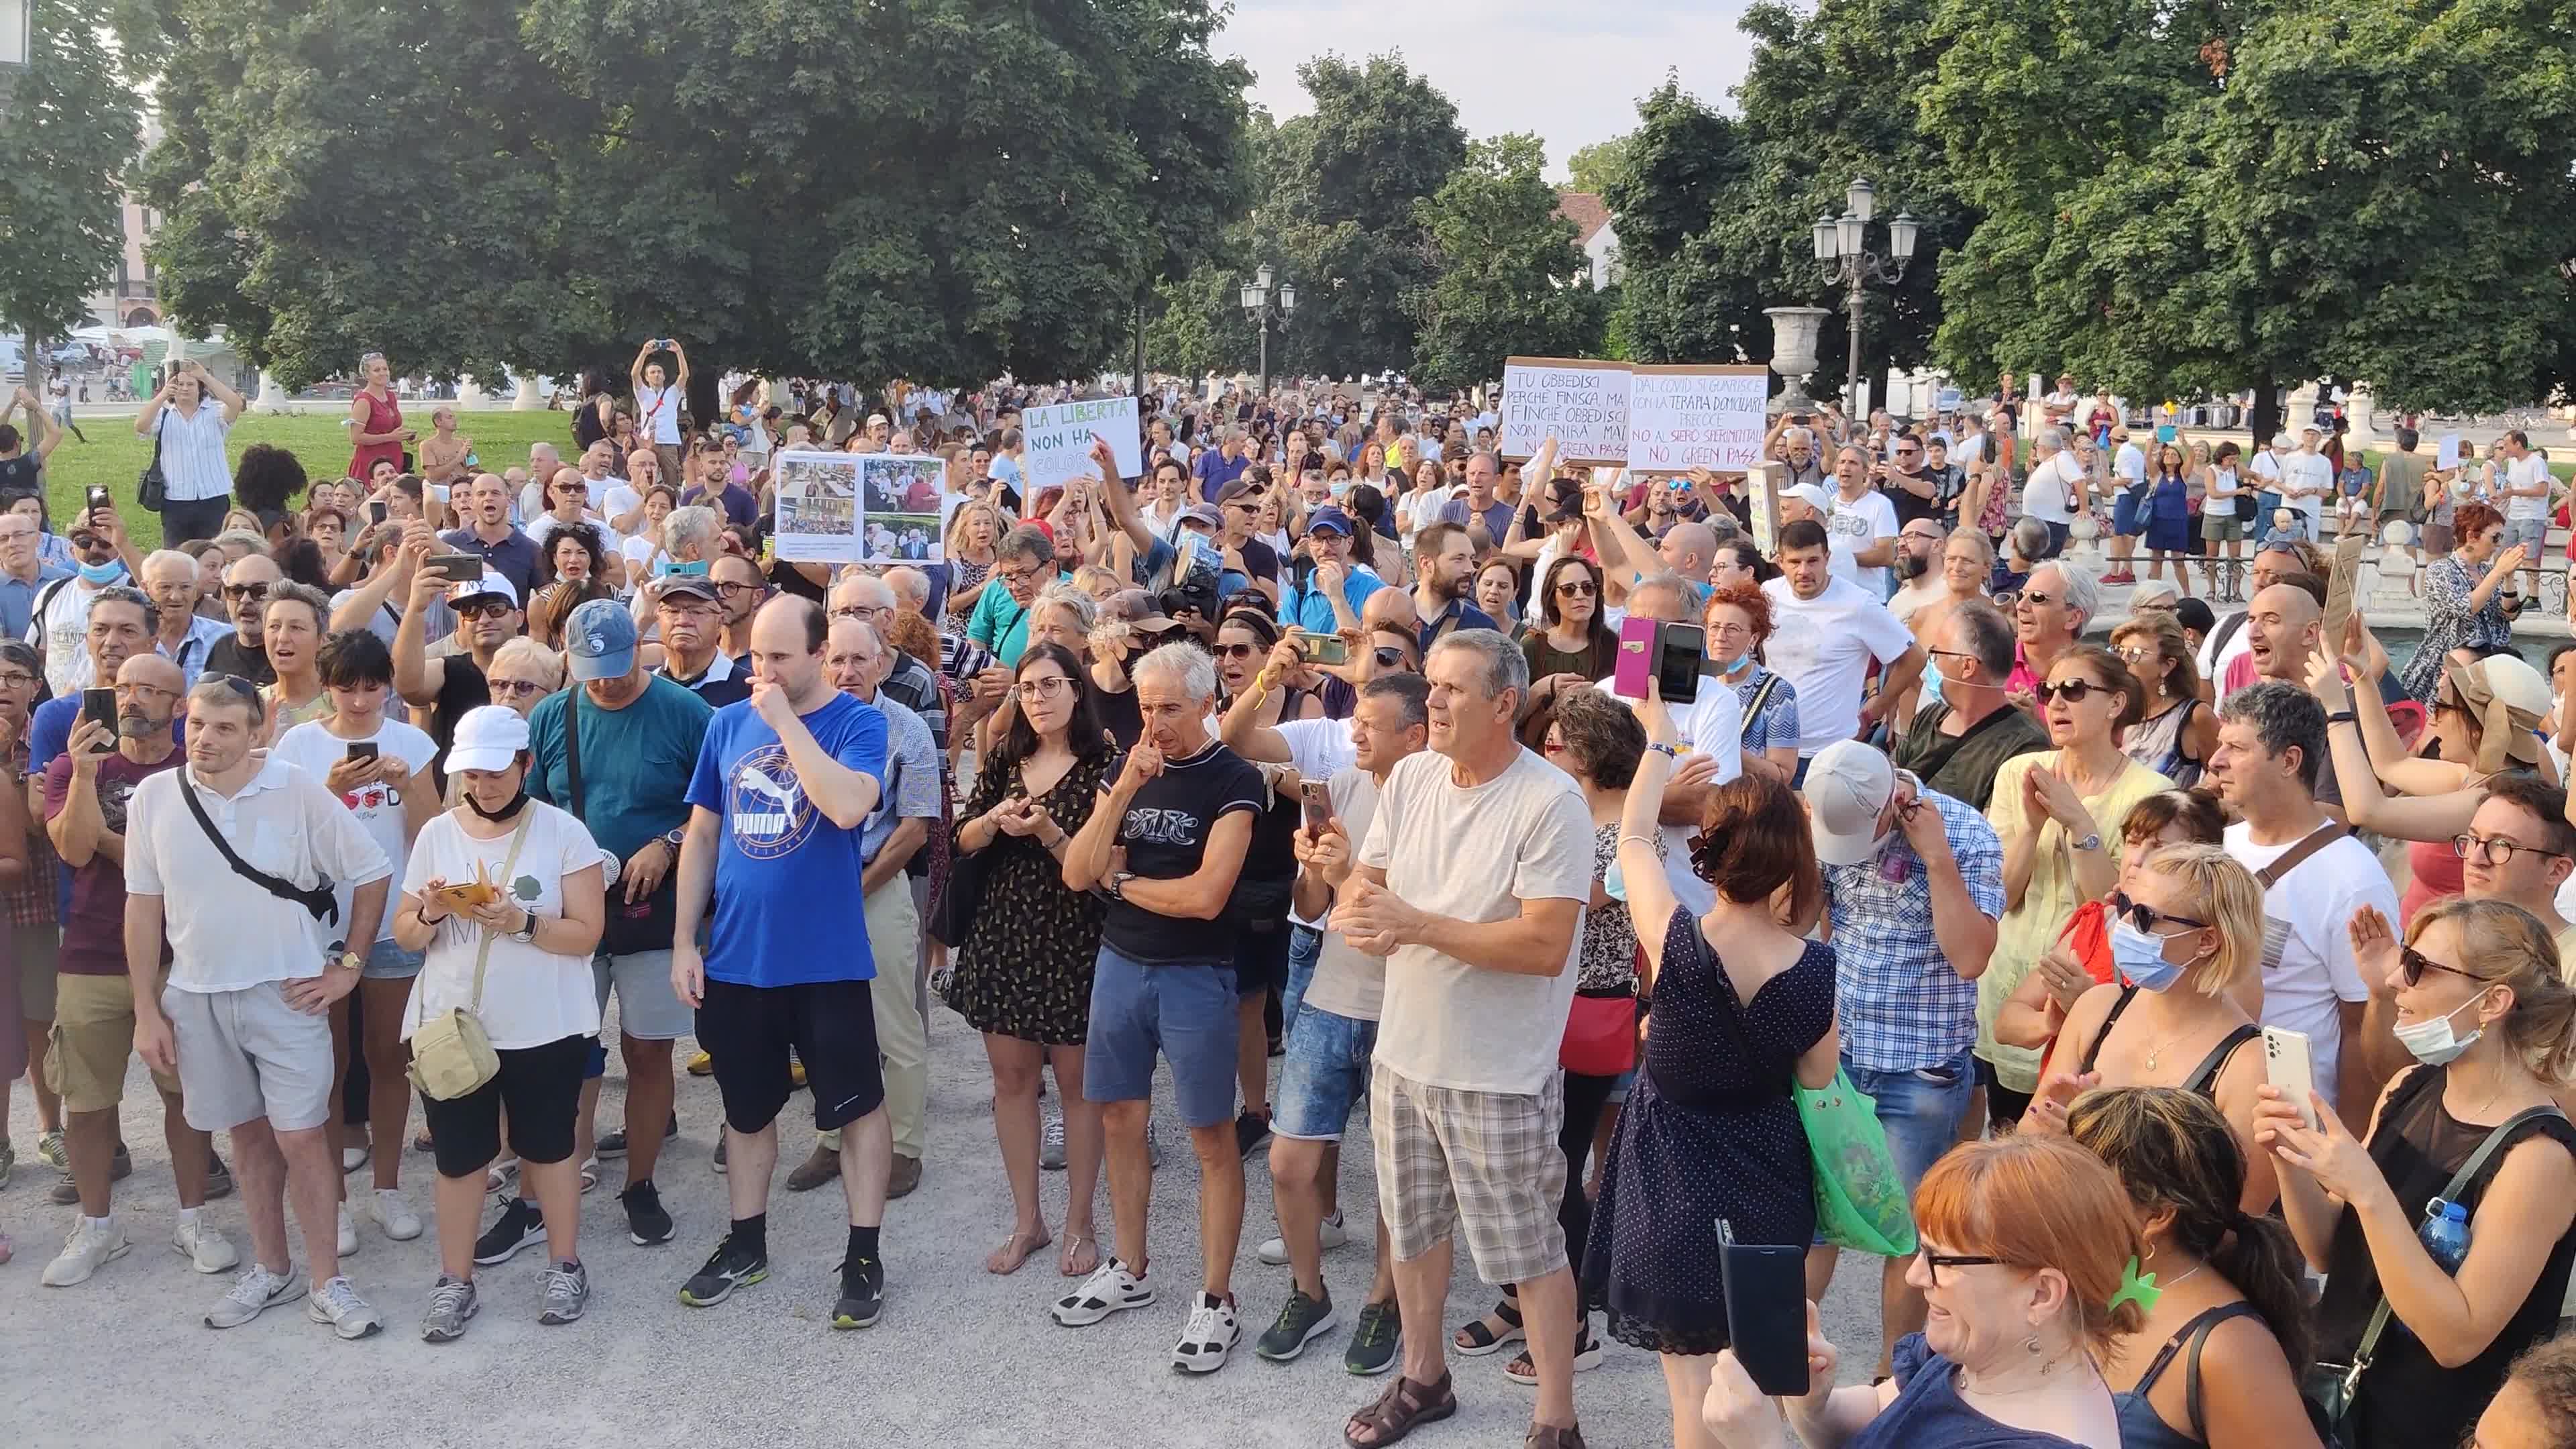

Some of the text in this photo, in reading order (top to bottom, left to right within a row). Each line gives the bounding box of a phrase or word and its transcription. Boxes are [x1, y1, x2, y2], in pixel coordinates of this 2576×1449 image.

[1513, 372, 1600, 389] TU OBBEDISCI
[1607, 393, 1624, 407] MA
[1669, 395, 1711, 411] TERAPIA
[1029, 409, 1051, 429] LA
[1566, 407, 1627, 423] OBBEDISCI
[1680, 413, 1723, 427] PRECOCE
[1031, 427, 1092, 451] NON HA
[1510, 424, 1537, 437] NON
[1603, 425, 1627, 441] MAI
[1632, 429, 1651, 442] NO
[1670, 429, 1700, 443] SIERO
[1560, 441, 1594, 456] GREEN
[1600, 443, 1628, 458] PASS
[1648, 445, 1758, 464] NO GREEN PASS
[733, 813, 786, 835] PUMA
